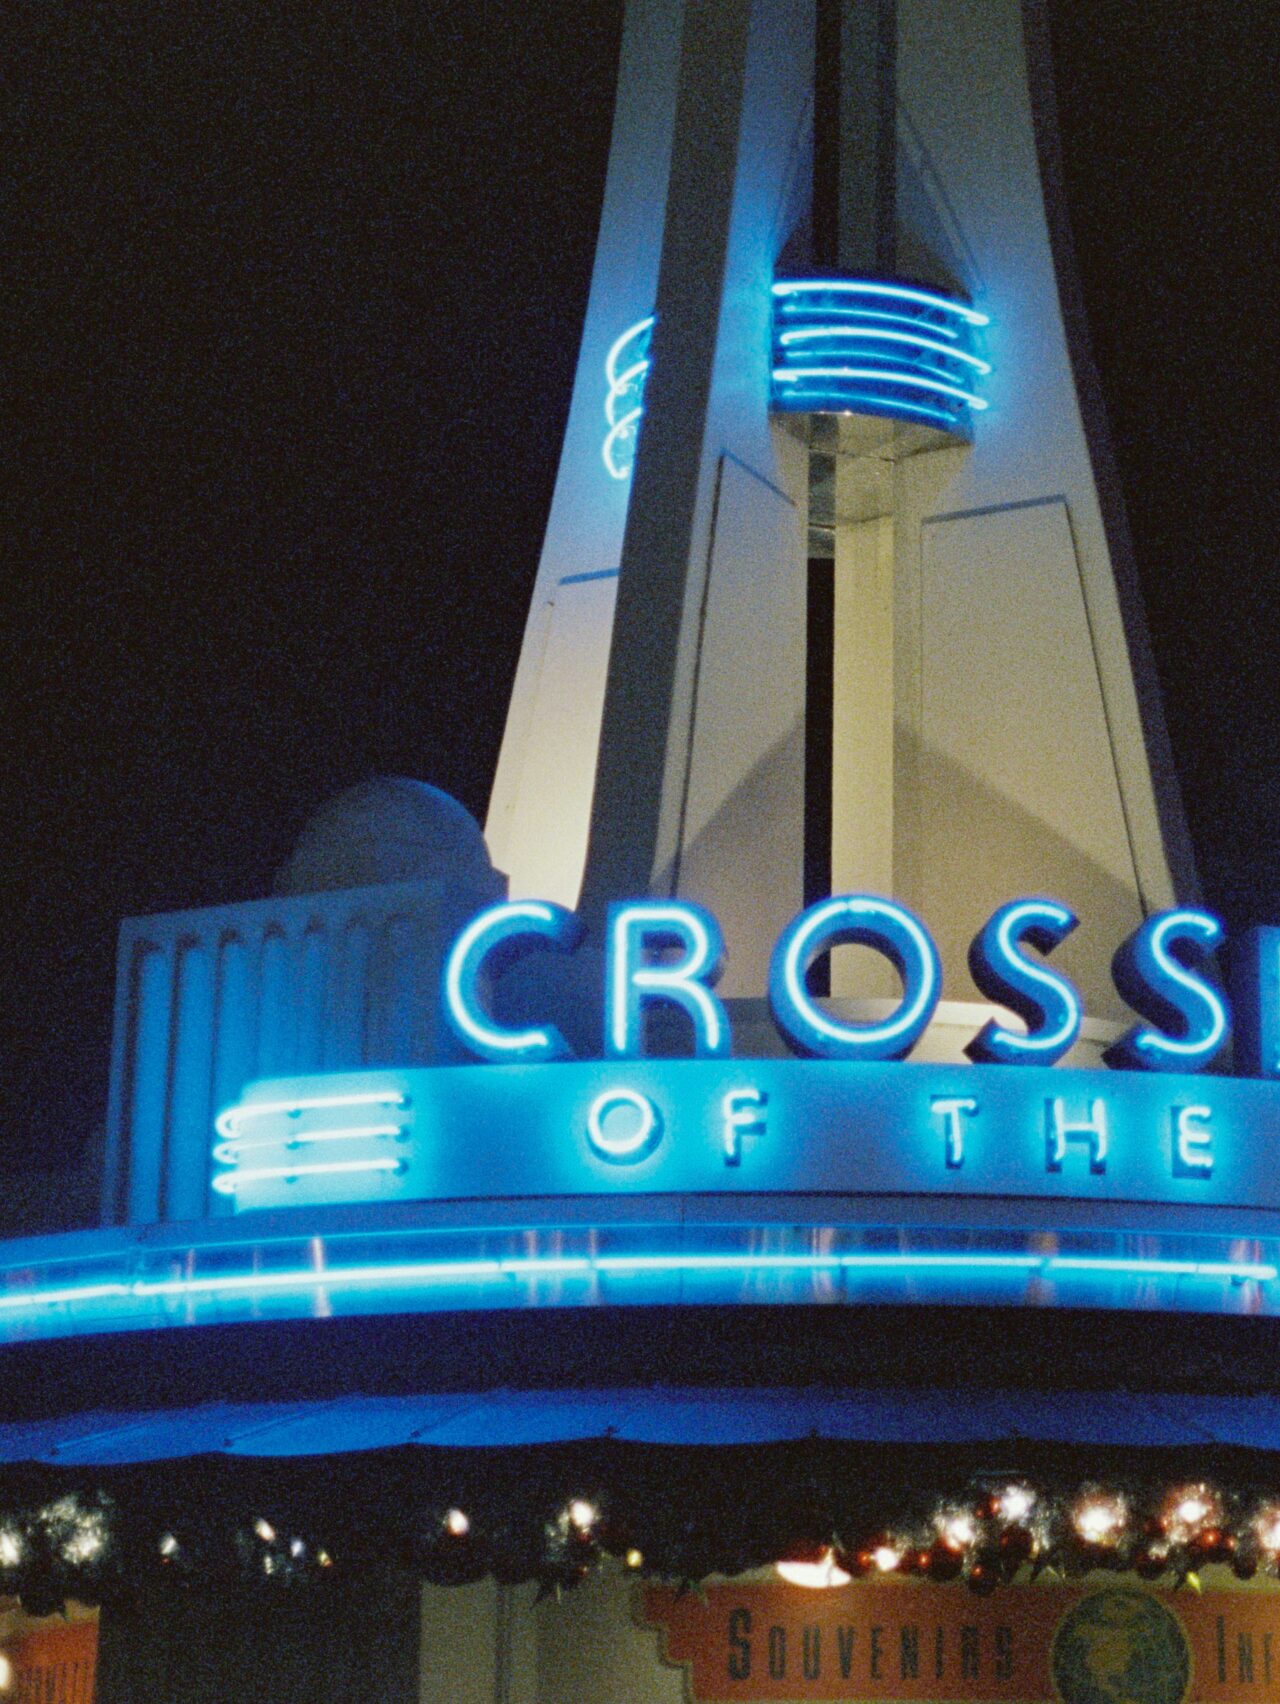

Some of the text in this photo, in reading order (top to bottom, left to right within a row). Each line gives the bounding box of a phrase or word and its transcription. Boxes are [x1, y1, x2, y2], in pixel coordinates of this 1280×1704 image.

[586, 1086, 768, 1168] OF
[928, 1094, 1216, 1180] THE
[728, 1608, 1014, 1682] SOUVENIRS
